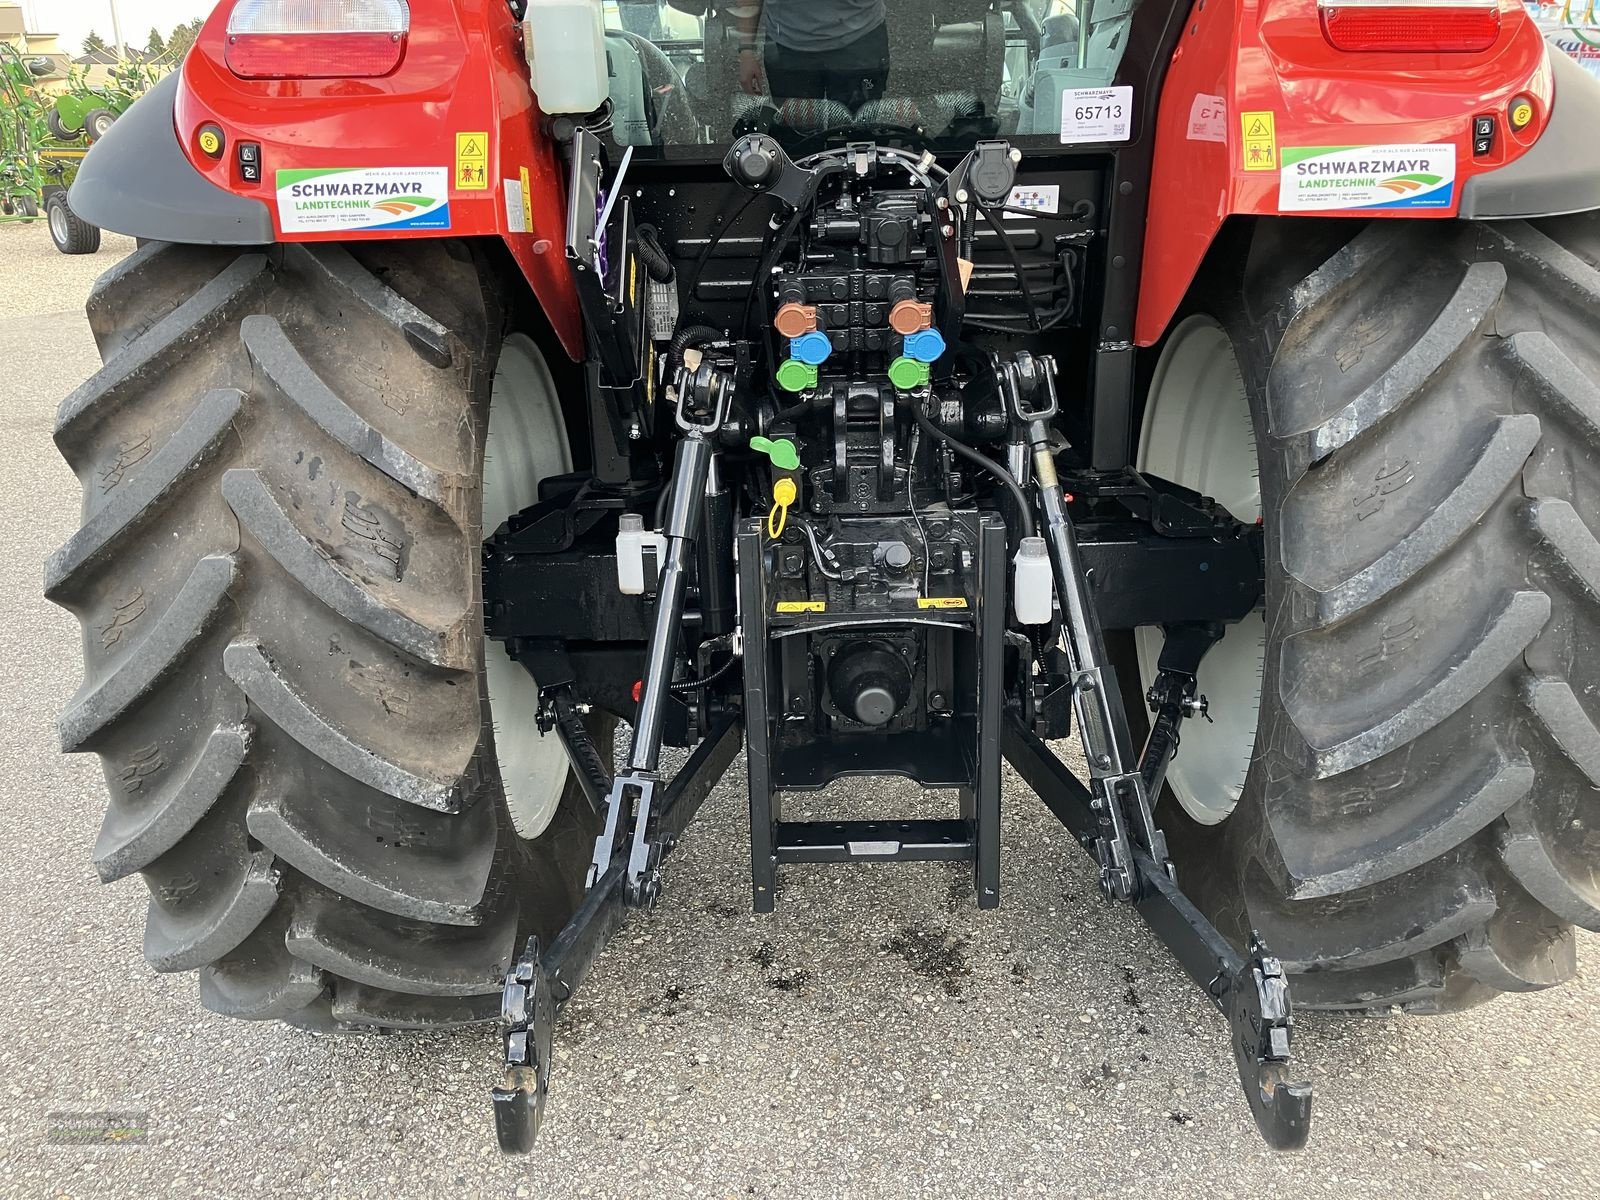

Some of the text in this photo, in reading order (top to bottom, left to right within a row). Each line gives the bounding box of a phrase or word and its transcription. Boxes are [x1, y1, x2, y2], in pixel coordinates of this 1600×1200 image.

[1075, 105, 1122, 120] 65713
[1297, 160, 1430, 176] SCHWARZMAYR
[292, 182, 422, 197] SCHWARZMAYR
[1299, 178, 1377, 188] LANDTECHNIK
[296, 200, 371, 210] LANDTECHNIK
